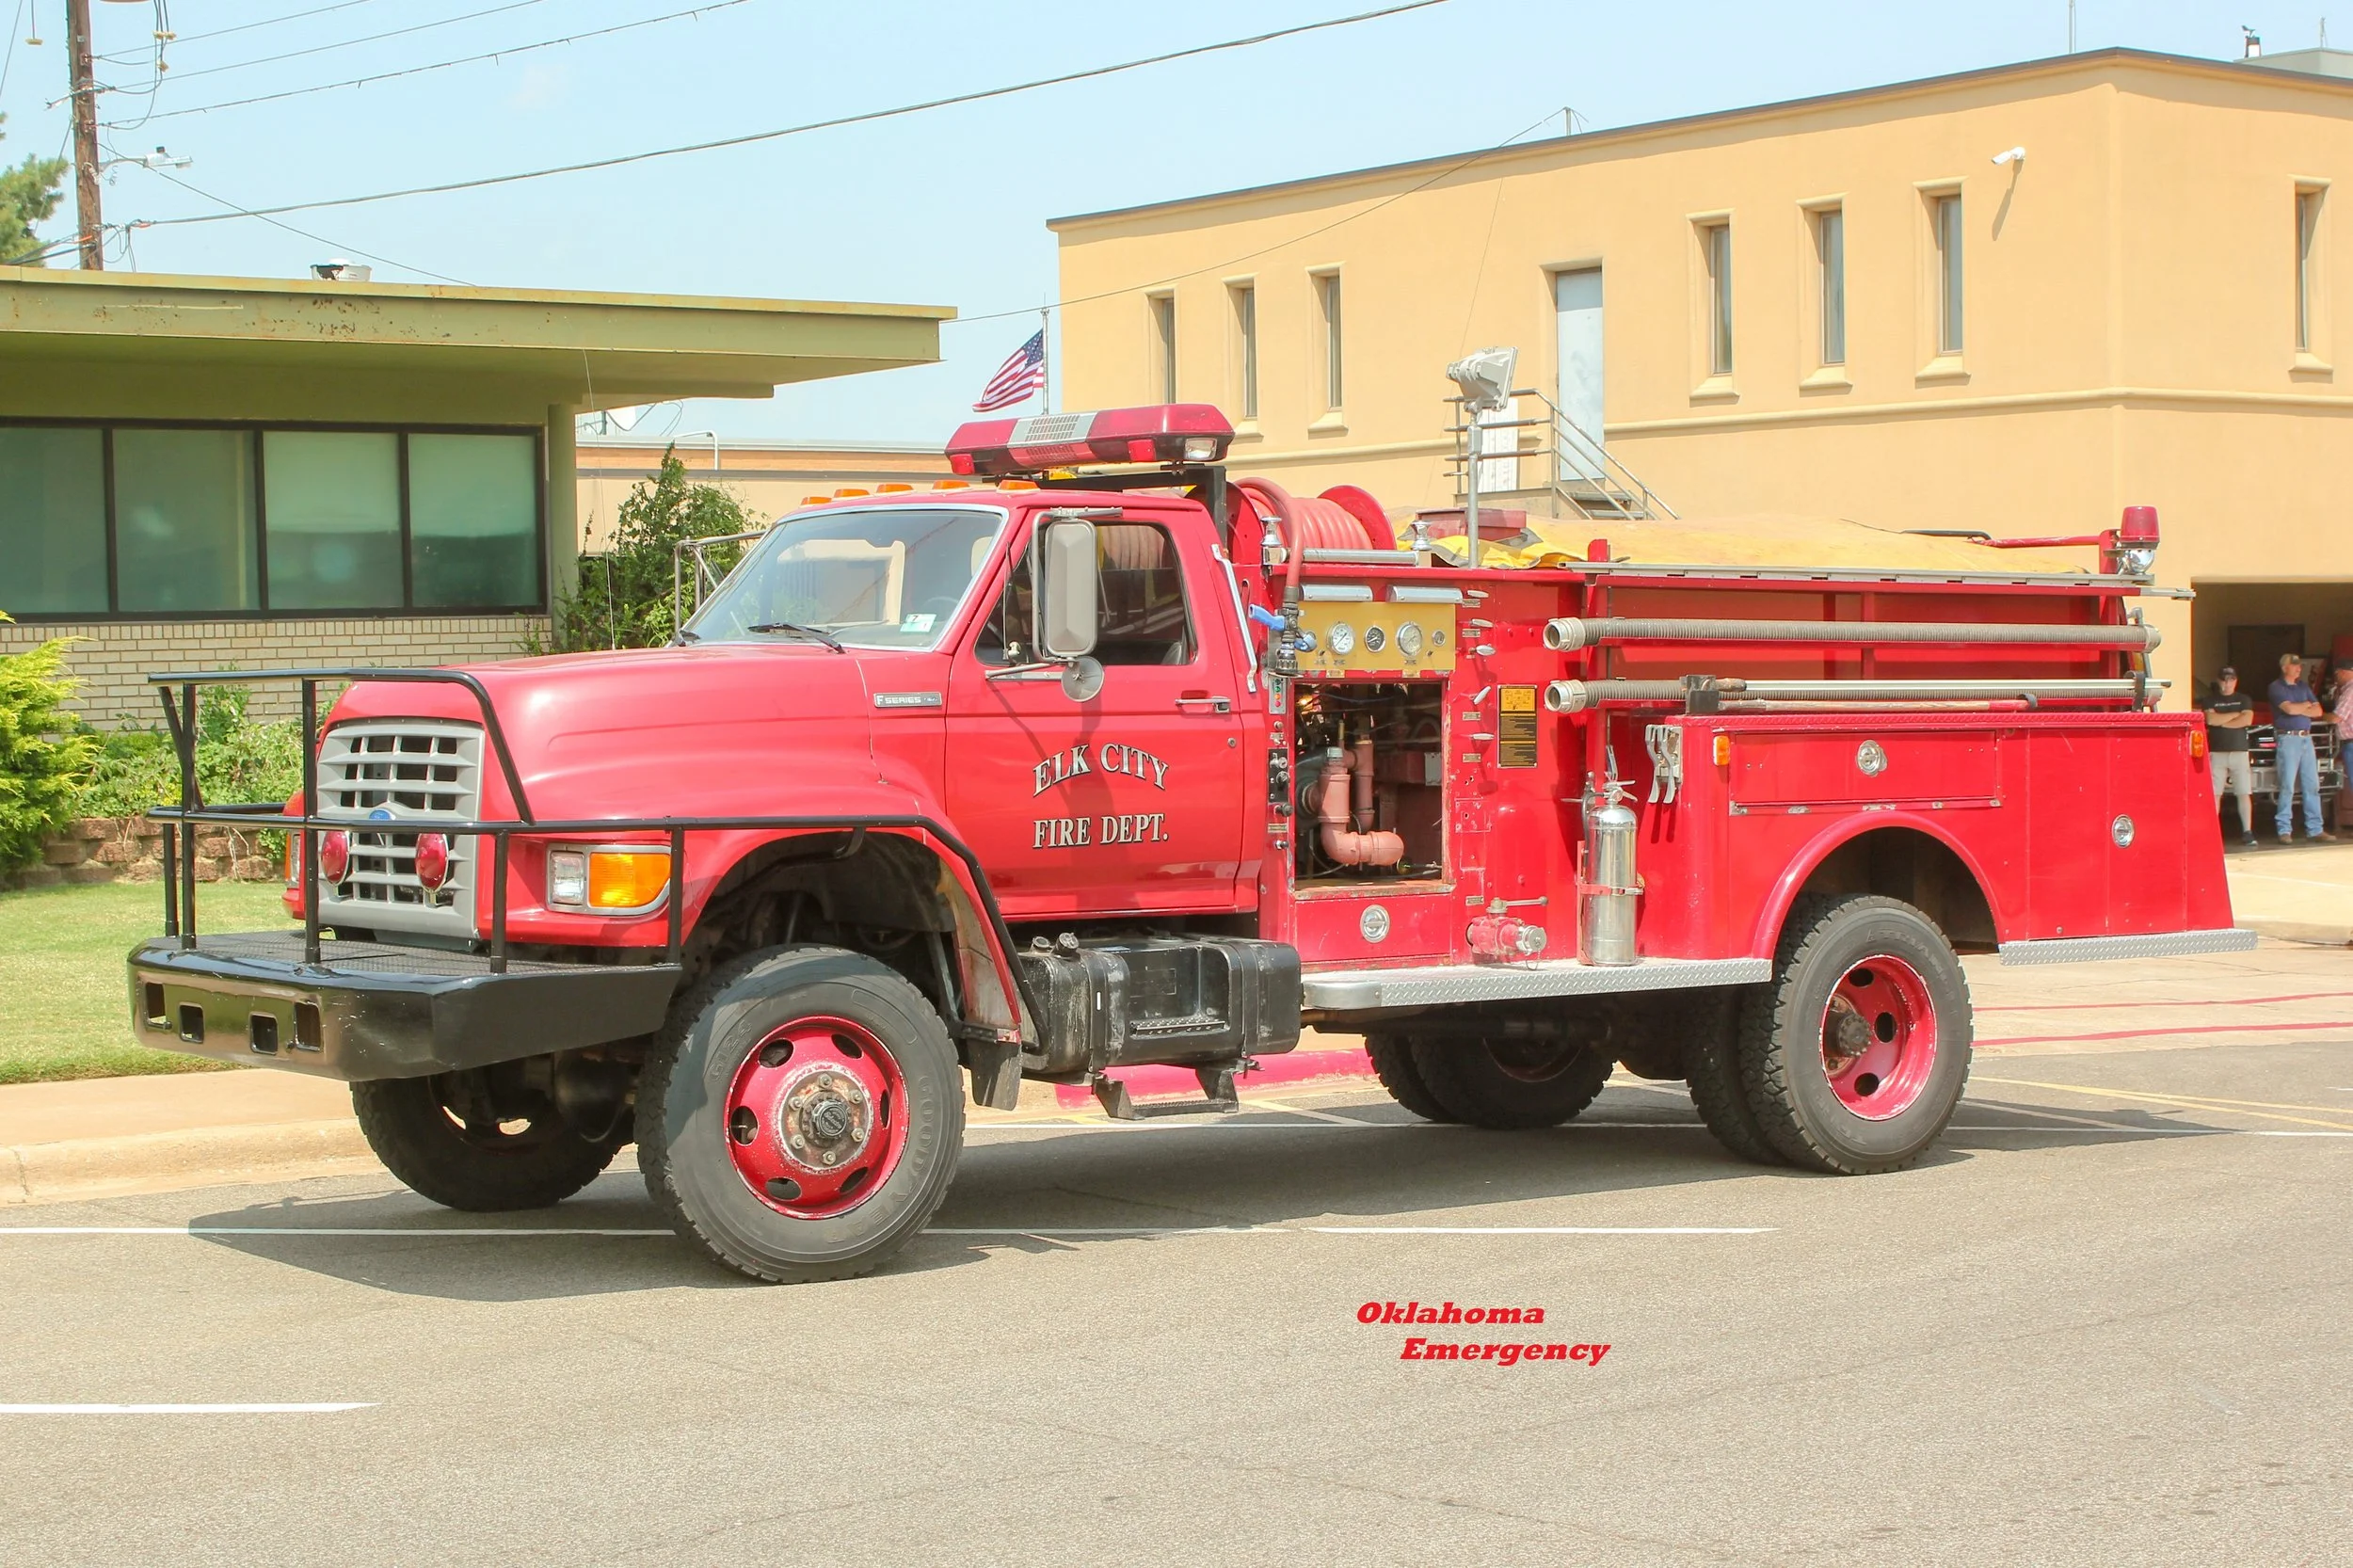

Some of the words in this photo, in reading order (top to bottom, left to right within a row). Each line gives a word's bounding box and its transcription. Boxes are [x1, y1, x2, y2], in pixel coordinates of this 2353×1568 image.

[885, 696, 921, 705] SERIES
[1032, 744, 1092, 797] ELK
[1099, 743, 1170, 791] CITY
[1032, 817, 1092, 848] FIRE
[1099, 812, 1170, 844] DEPT.
[824, 1076, 936, 1244] GOODYEAR
